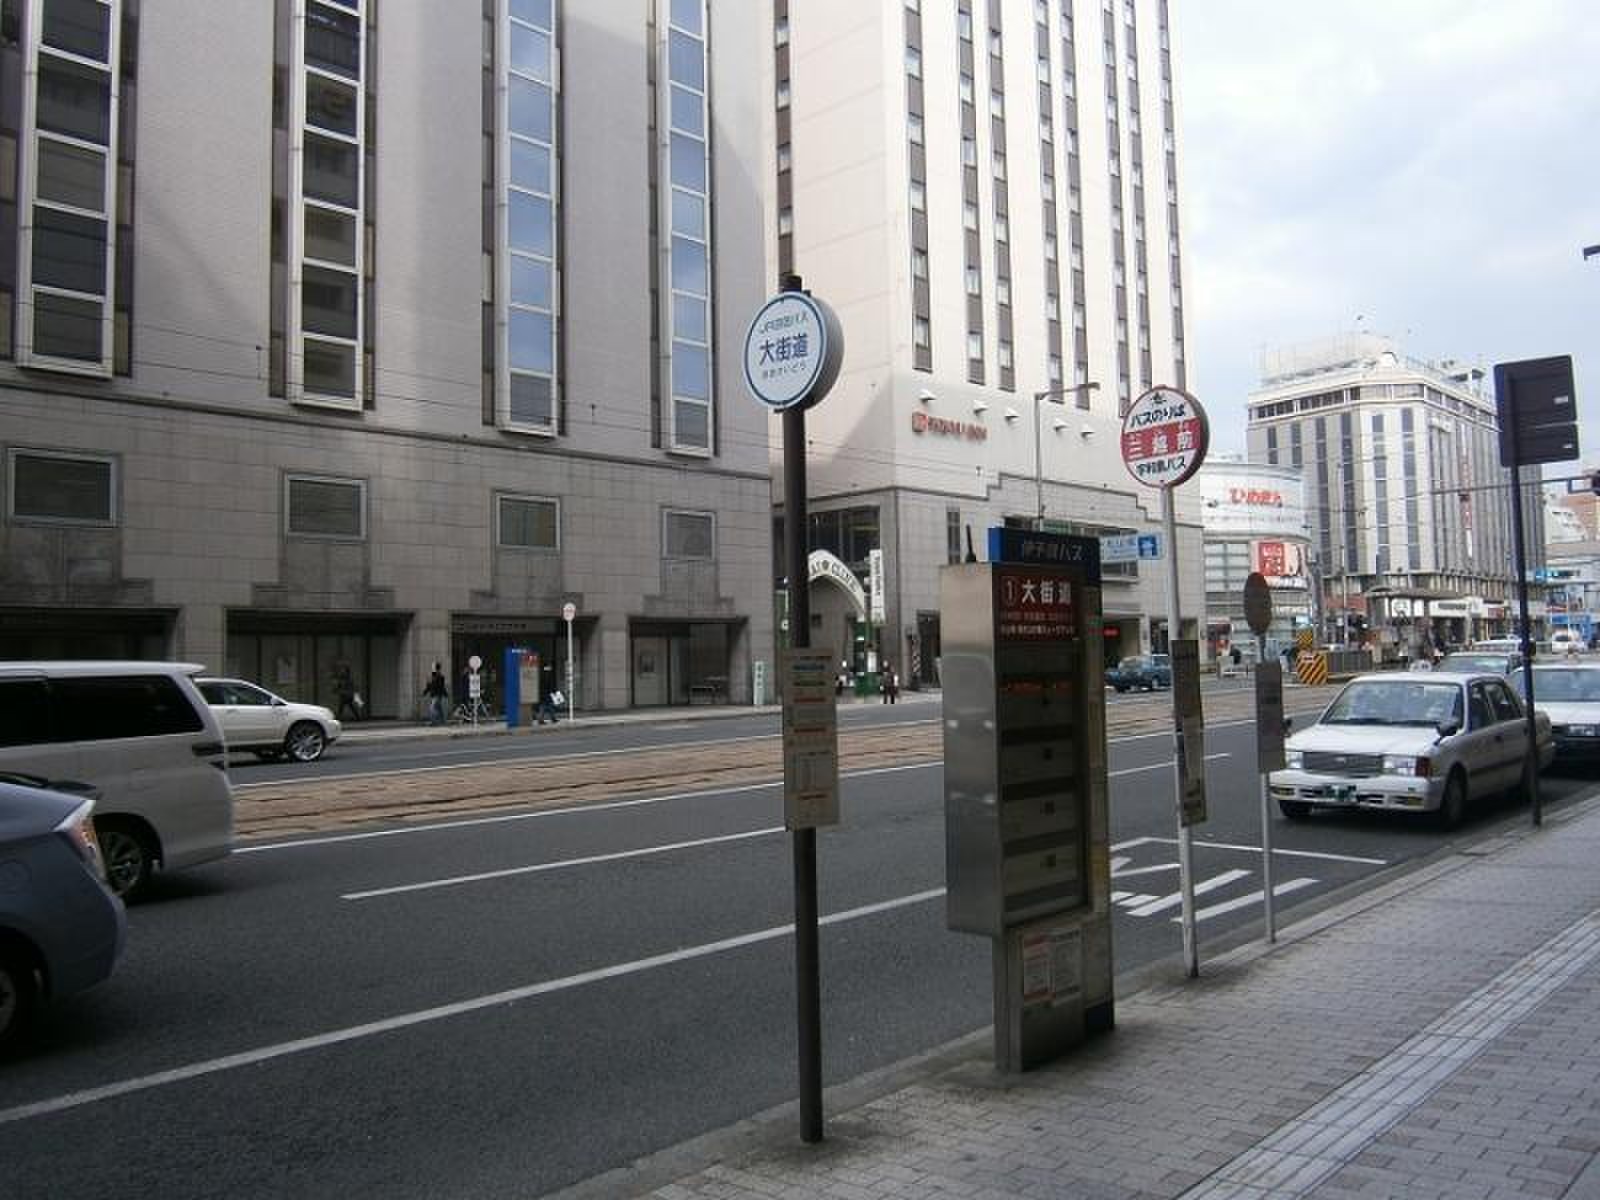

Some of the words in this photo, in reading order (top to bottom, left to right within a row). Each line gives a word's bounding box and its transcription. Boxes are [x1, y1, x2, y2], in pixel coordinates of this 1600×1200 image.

[759, 333, 808, 366] 大街道
[1130, 404, 1185, 428] バスのりば
[1021, 578, 1072, 605] 大街道
